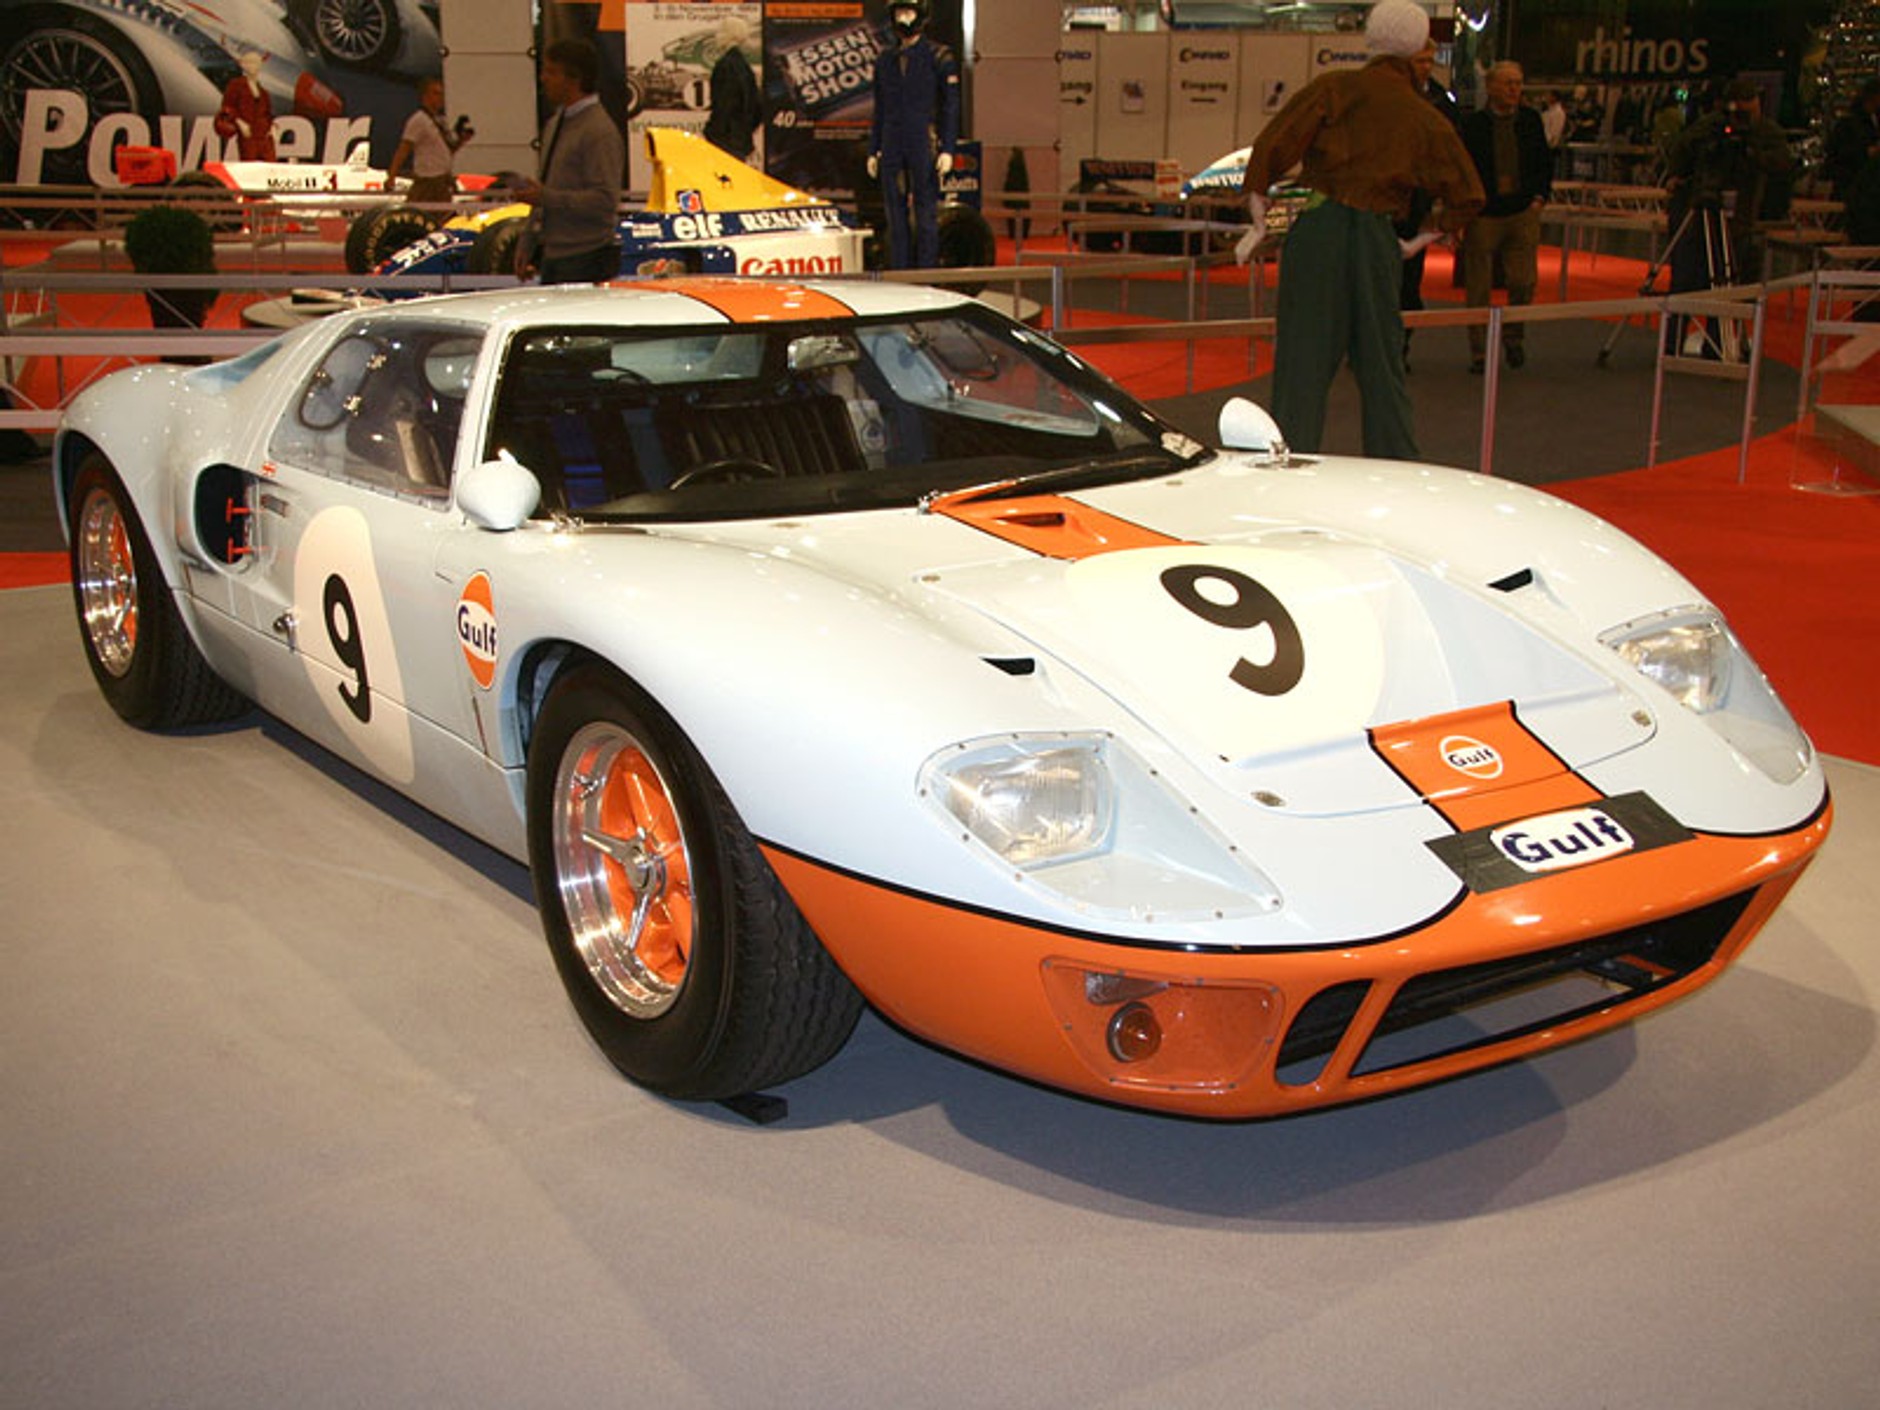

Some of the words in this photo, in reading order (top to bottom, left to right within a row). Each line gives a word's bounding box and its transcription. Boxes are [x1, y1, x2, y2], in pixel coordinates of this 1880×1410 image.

[787, 30, 869, 64] ESSEN
[788, 45, 877, 87] MOTOR
[1576, 26, 1709, 73] rhinos
[16, 89, 372, 189] Power
[772, 110, 797, 128] 40
[673, 212, 723, 241] elf
[739, 208, 841, 232] RENAULT
[741, 256, 843, 276] Canon
[323, 573, 372, 724] 9
[458, 604, 497, 657] Gulf
[1159, 564, 1306, 697] 9
[1447, 747, 1495, 768] Gulf
[1501, 816, 1625, 864] Gulf
